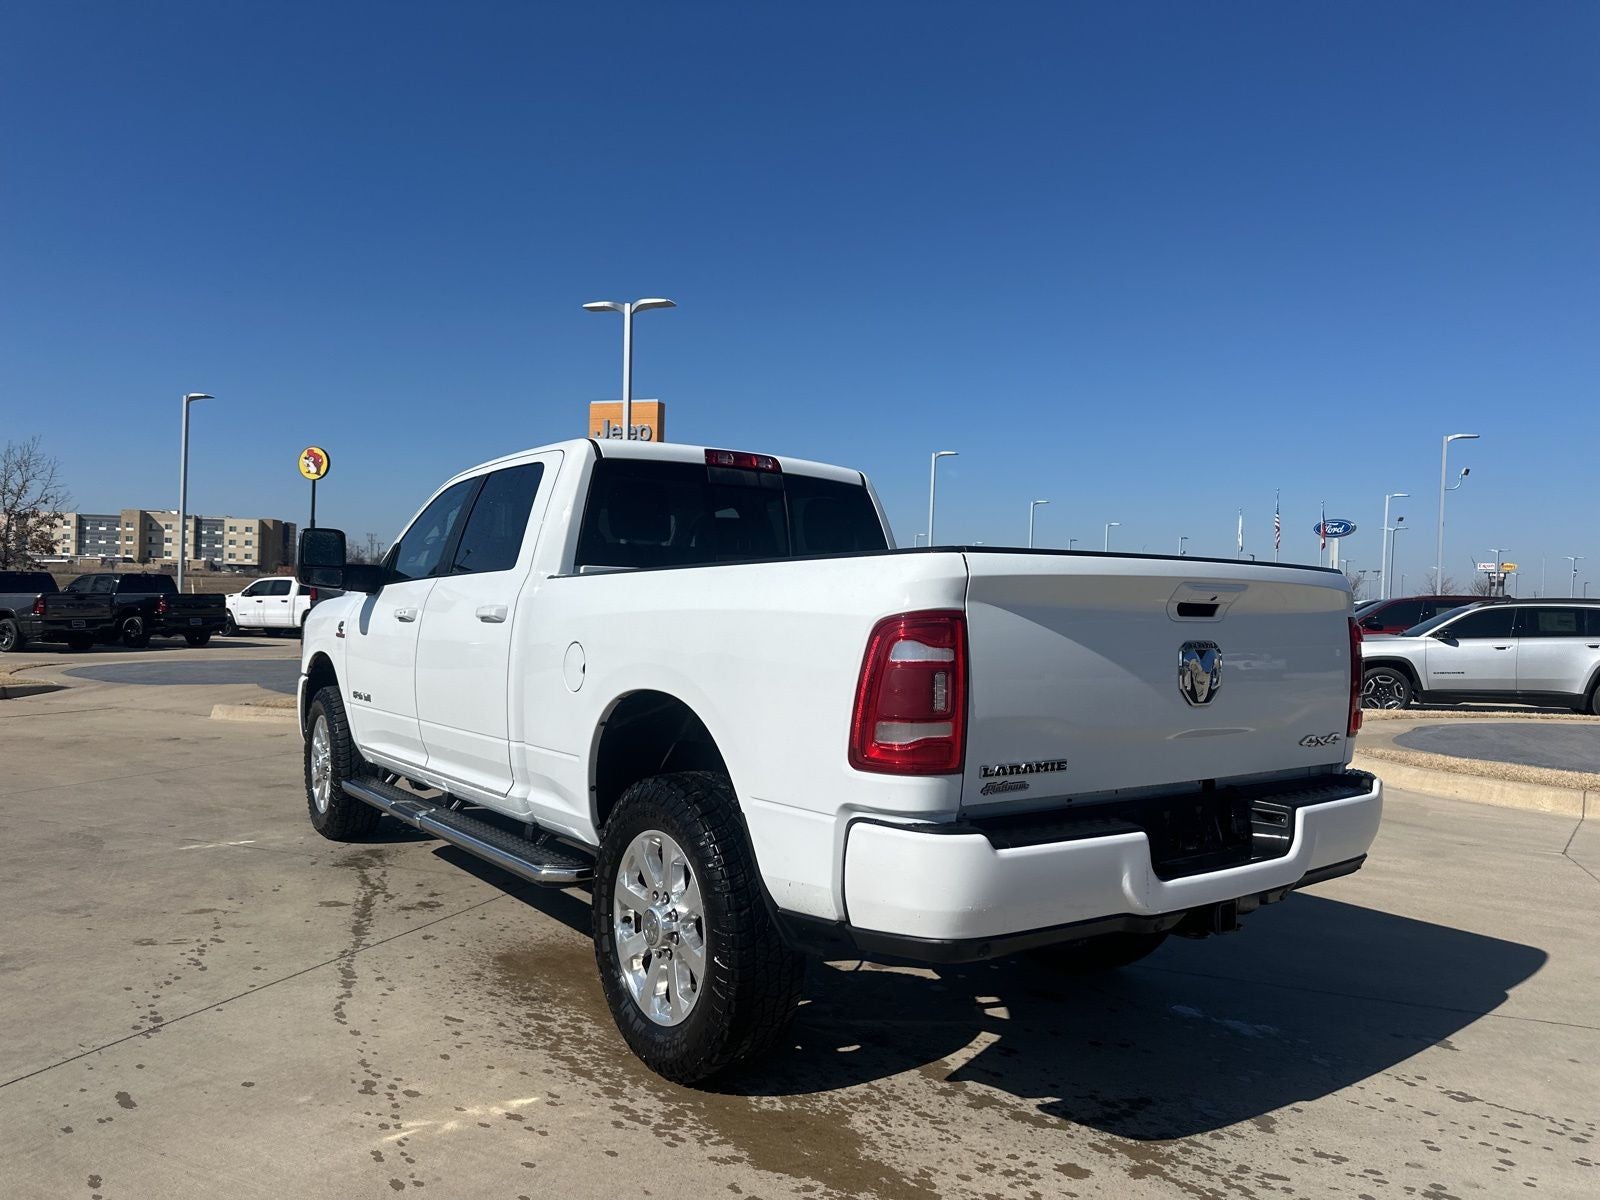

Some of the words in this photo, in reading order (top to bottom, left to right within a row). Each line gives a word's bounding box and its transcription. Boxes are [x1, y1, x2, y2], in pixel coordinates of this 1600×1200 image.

[1325, 522, 1345, 533] Ford
[1299, 732, 1340, 747] 4x4
[980, 759, 1068, 778] LARAMIE
